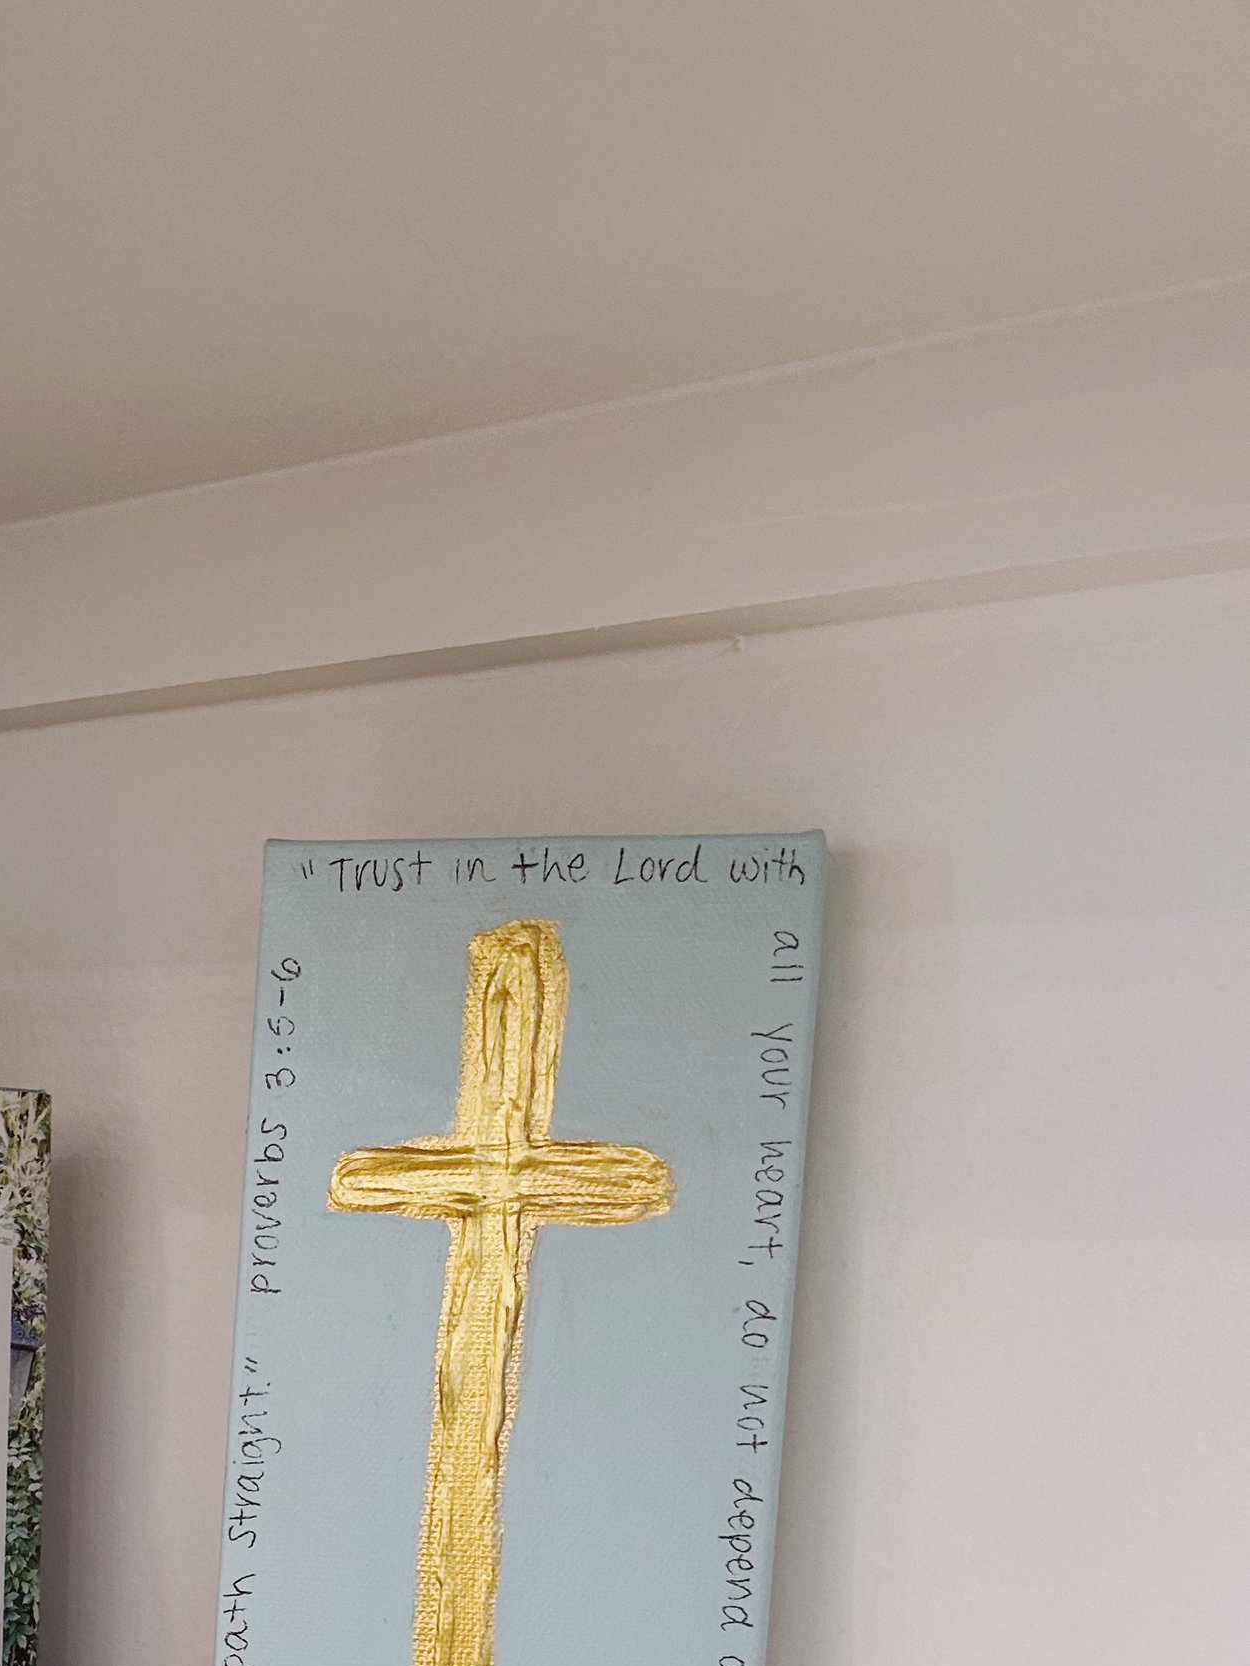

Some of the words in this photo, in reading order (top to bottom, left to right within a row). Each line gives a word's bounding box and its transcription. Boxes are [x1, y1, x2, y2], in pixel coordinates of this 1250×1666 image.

[454, 853, 497, 883] in
[512, 849, 588, 883] the
[613, 845, 708, 885] Lord
[730, 847, 806, 886] with
[771, 930, 804, 984] all
[265, 957, 302, 1090] 3:5-6
[750, 1023, 794, 1110] your
[738, 1140, 793, 1266] heart,
[740, 1298, 778, 1349] do
[735, 1384, 769, 1454] not
[718, 1478, 764, 1632] depend
